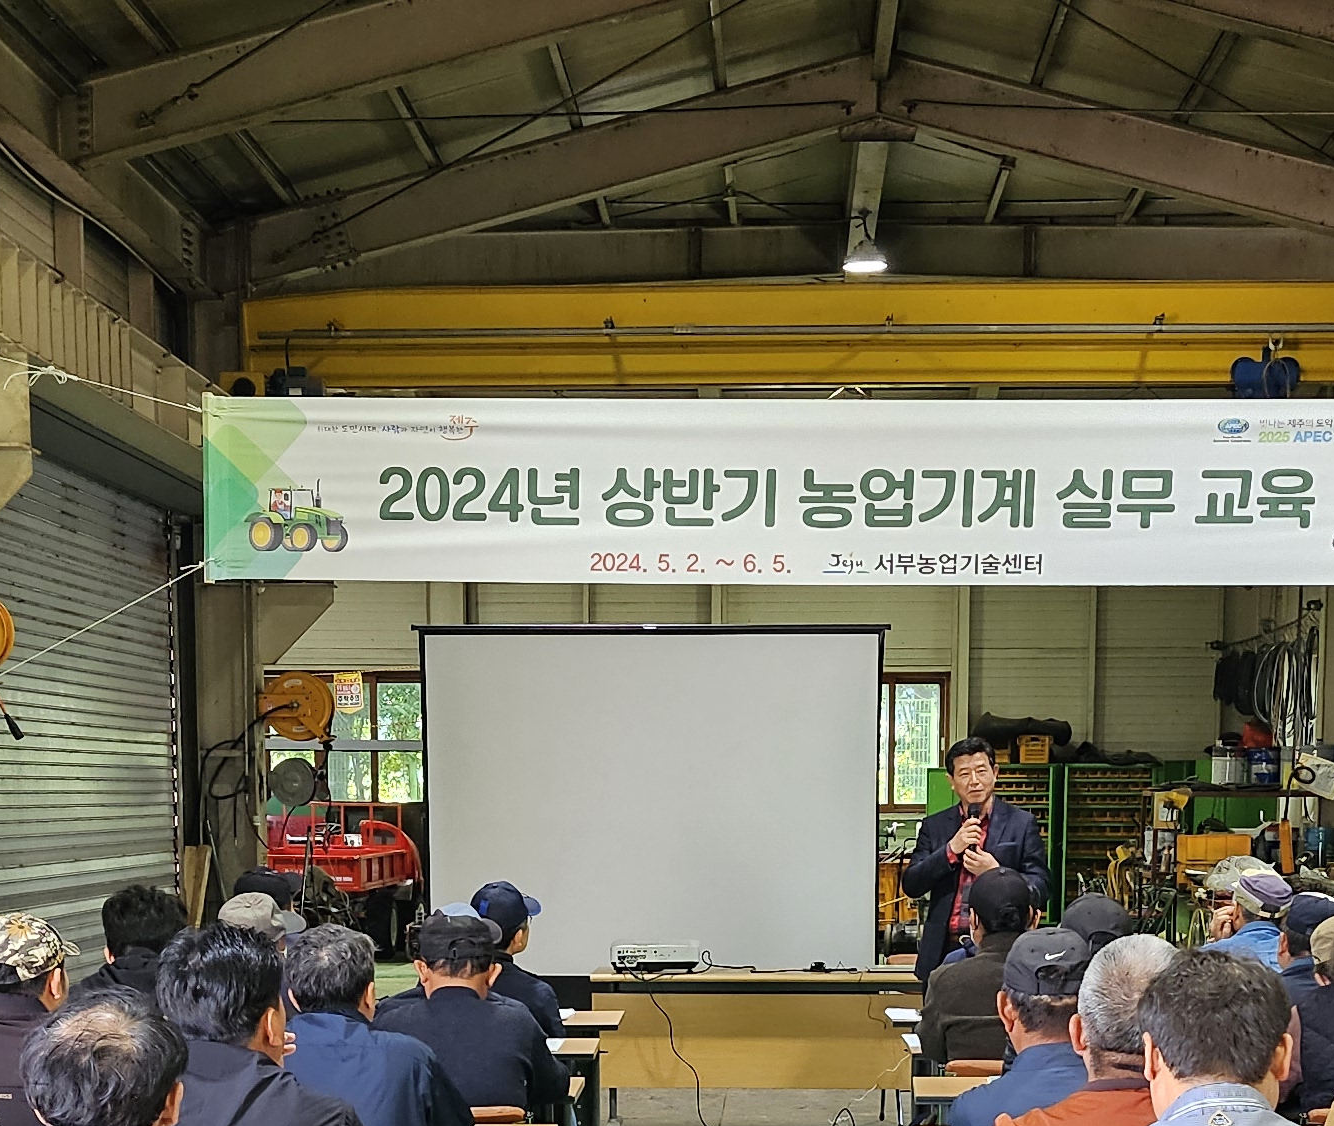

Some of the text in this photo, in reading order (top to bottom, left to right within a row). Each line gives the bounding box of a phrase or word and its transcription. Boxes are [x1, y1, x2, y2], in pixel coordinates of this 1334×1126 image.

[1258, 430, 1290, 443] 2025
[1293, 430, 1332, 443] APEC
[378, 466, 1316, 529] 2024년 상반기 농업기계 실무 교육
[590, 552, 647, 573] 2024.
[657, 553, 676, 573] 5.
[686, 553, 705, 573] 2.
[743, 553, 763, 574] 6.
[772, 554, 792, 574] 5.
[874, 553, 1043, 575] 서부농업기술센터
